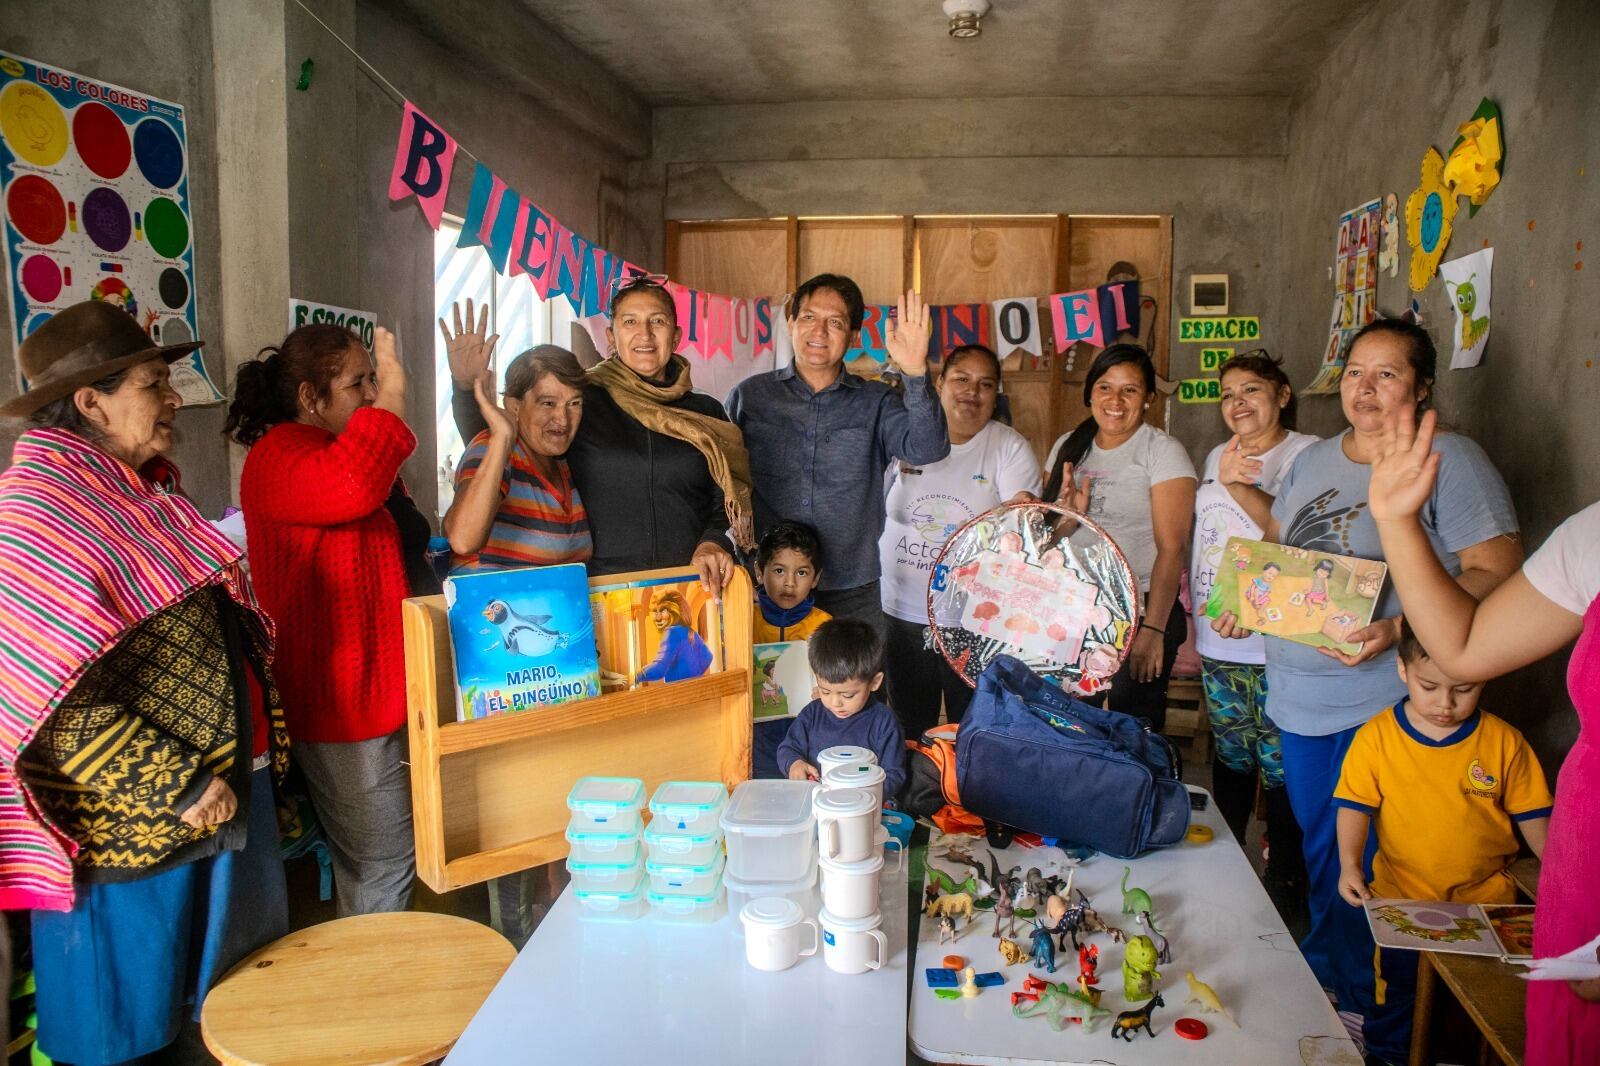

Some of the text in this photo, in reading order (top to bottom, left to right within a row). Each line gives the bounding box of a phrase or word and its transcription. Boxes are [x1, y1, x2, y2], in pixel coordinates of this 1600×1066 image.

[37, 67, 148, 112] LOS COLORES
[1181, 319, 1258, 339] ESPACIO
[1203, 350, 1229, 368] DE
[916, 494, 975, 518] RECONOCIMIENTO
[506, 665, 562, 686] MARIO,
[489, 682, 583, 711] EL PINGÜINO
